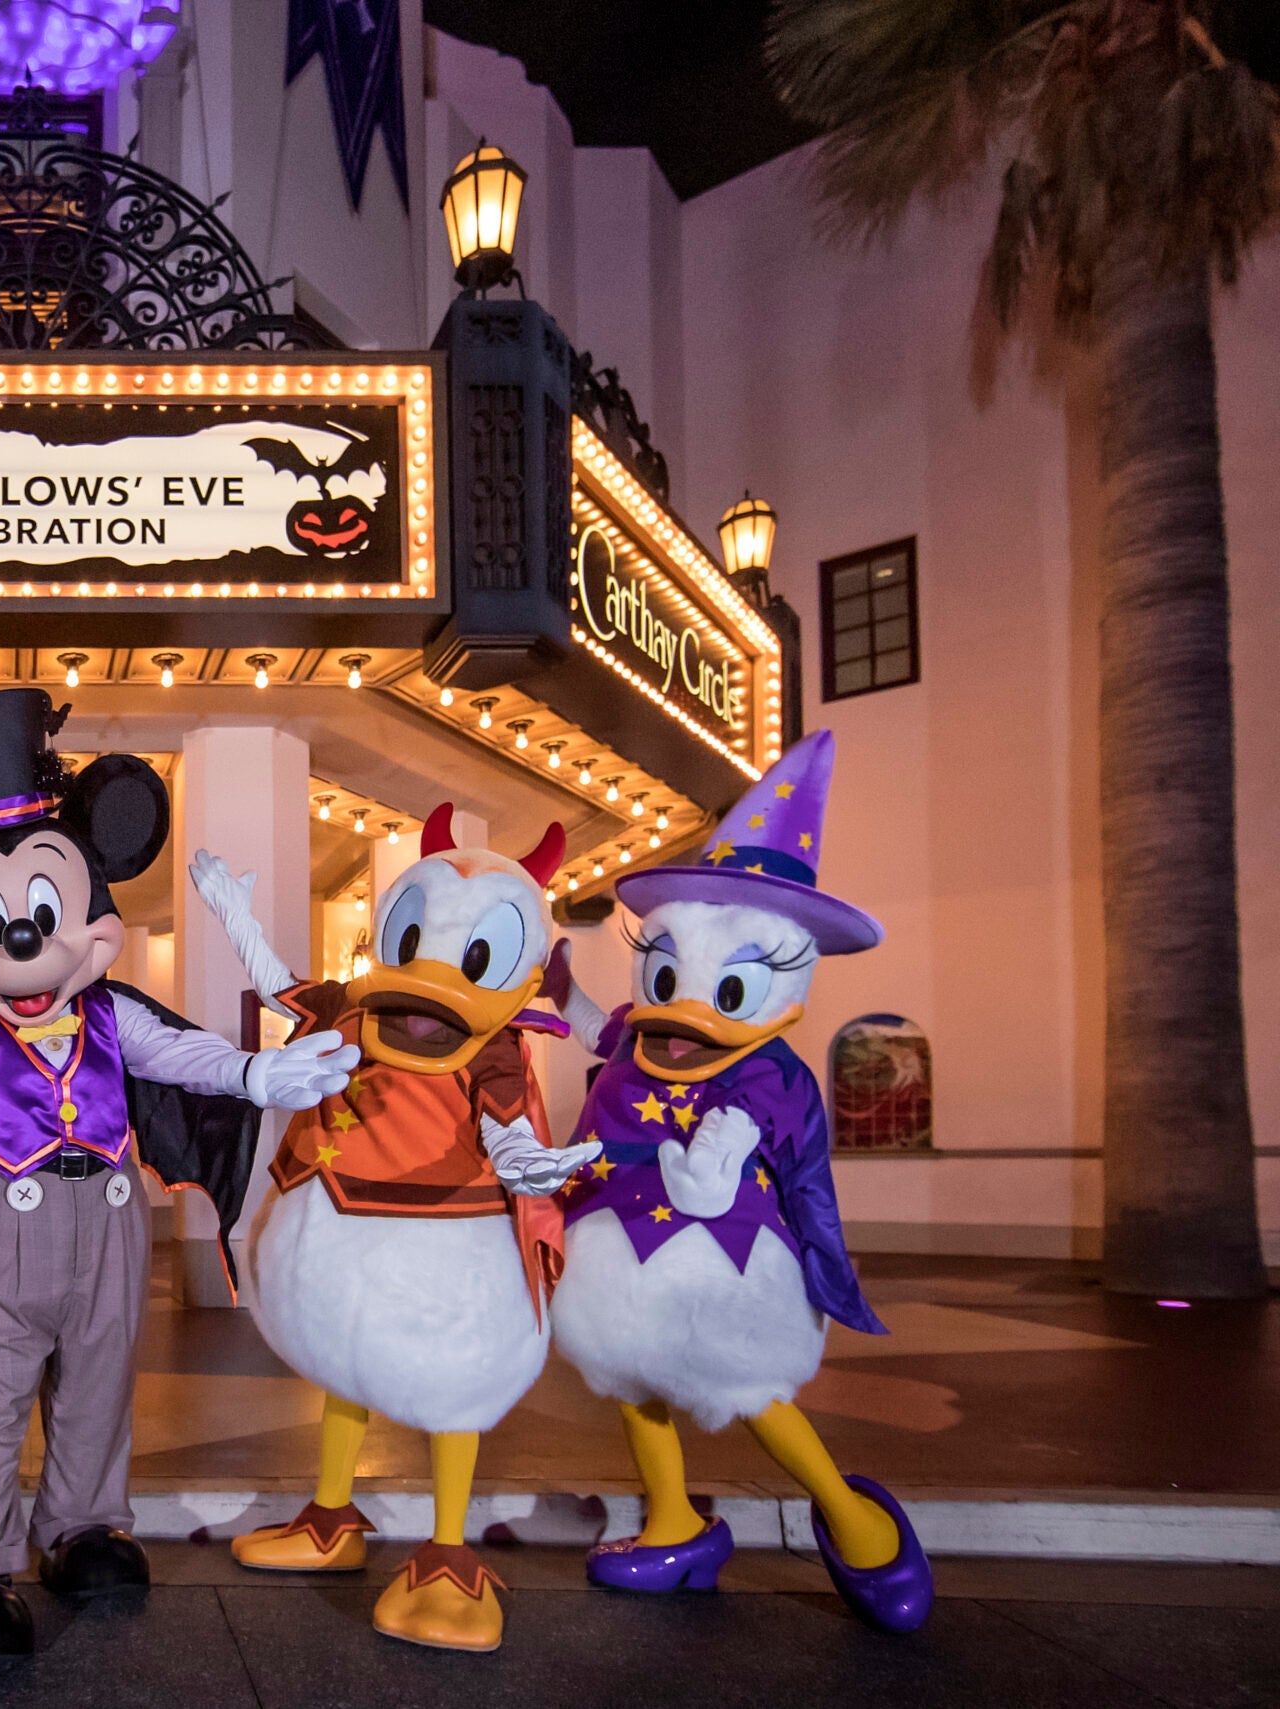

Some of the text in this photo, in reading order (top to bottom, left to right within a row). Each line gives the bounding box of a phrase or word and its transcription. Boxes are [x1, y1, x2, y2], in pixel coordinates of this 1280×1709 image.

[163, 476, 244, 506] EVE
[577, 525, 741, 727] Carthay Circle
